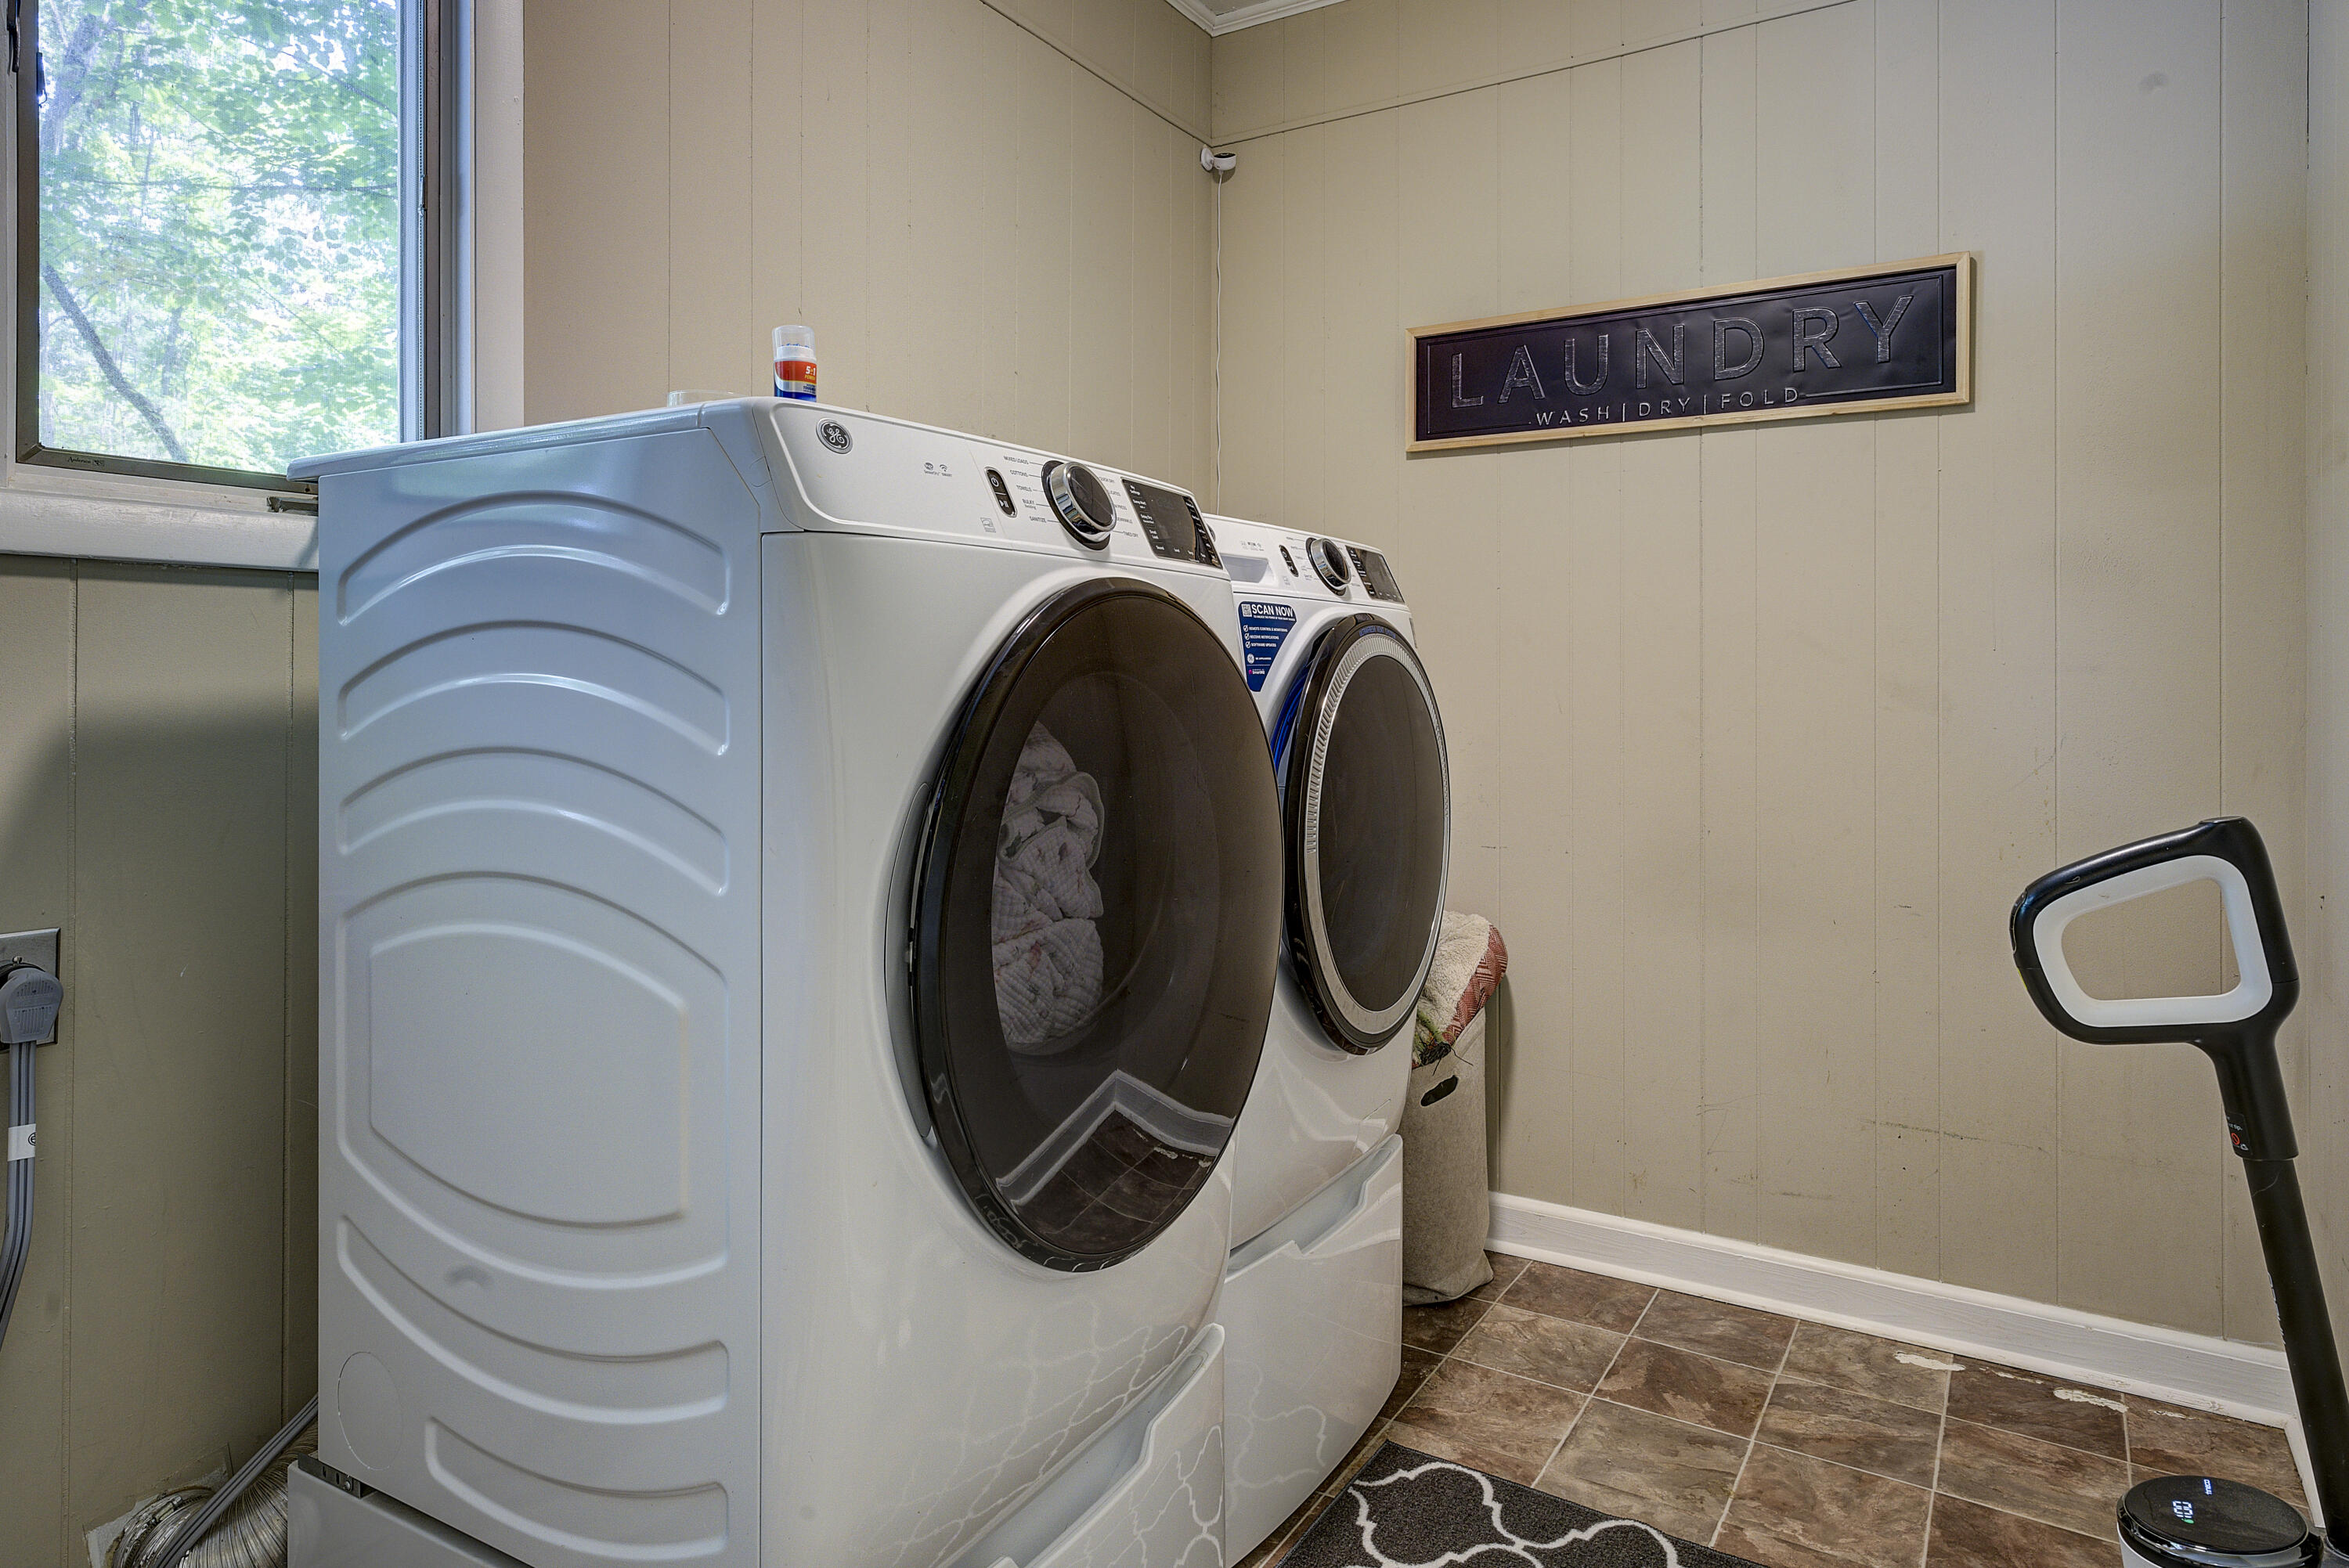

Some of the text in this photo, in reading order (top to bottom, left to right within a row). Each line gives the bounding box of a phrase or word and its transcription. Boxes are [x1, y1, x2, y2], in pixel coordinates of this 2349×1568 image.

[1451, 294, 1914, 409] LAUNDRY
[1536, 387, 1799, 427] WASH DRY FOLD
[1251, 604, 1294, 618] SCAN NOW
